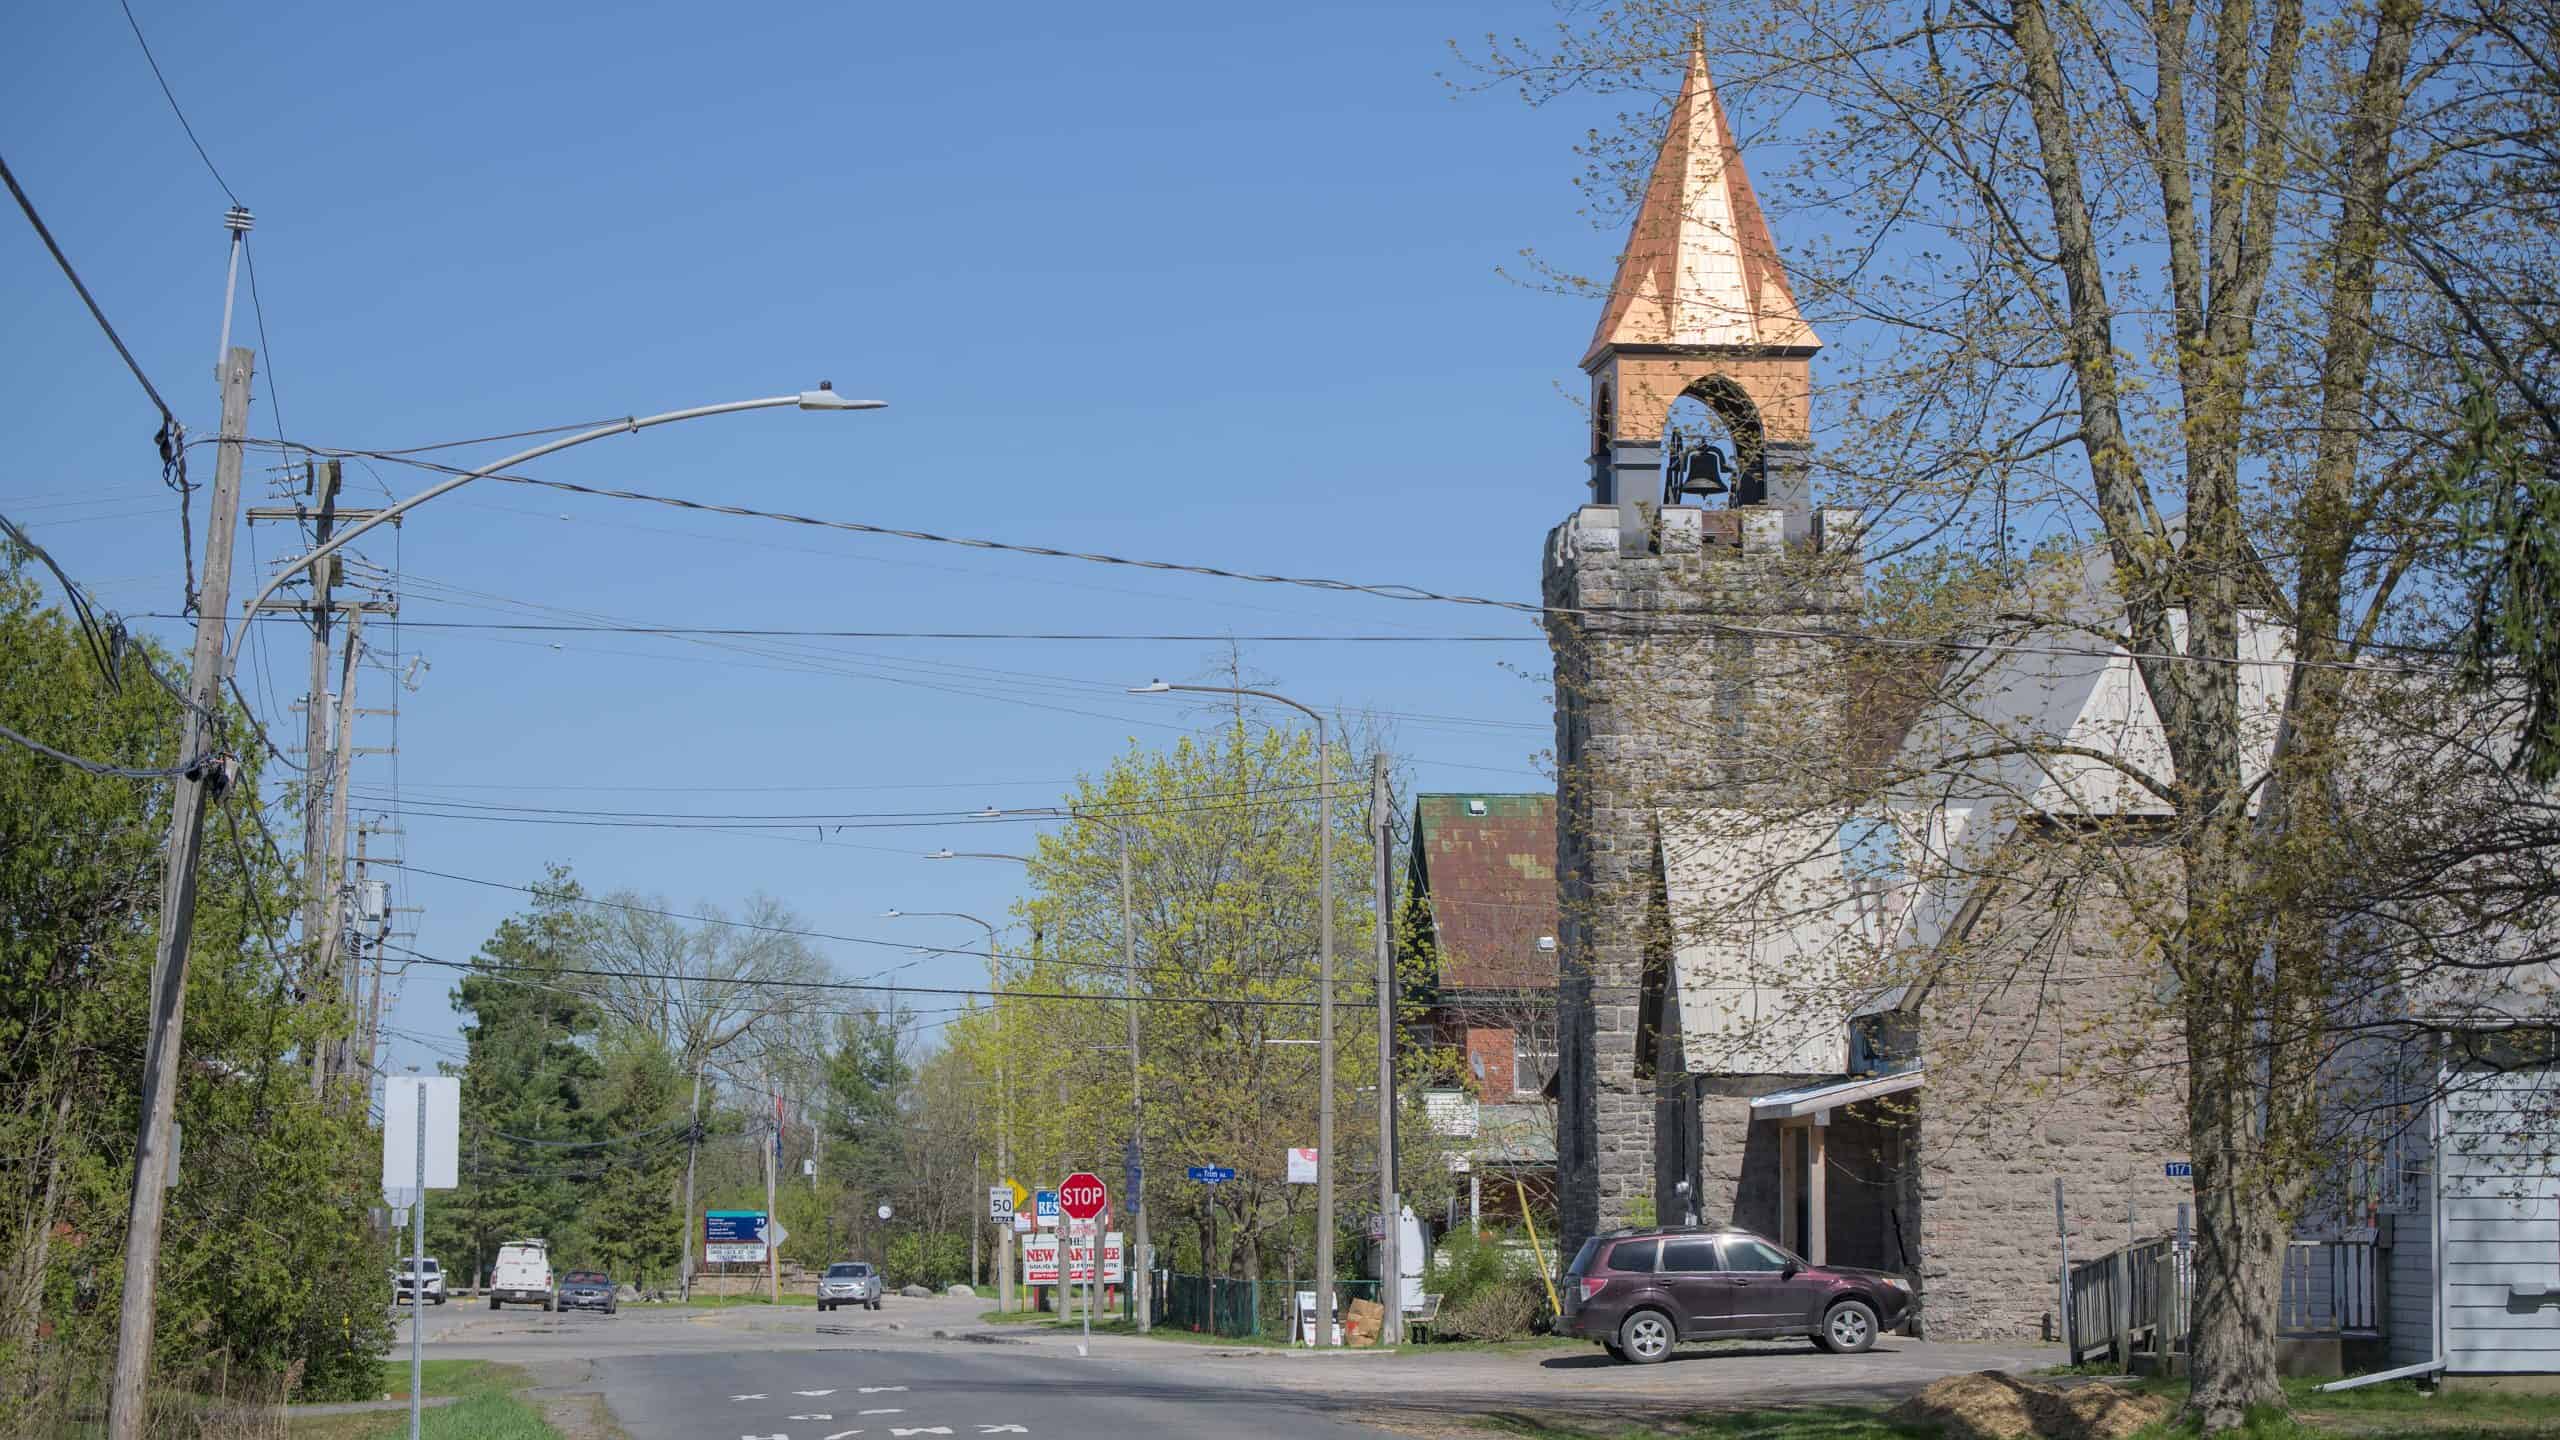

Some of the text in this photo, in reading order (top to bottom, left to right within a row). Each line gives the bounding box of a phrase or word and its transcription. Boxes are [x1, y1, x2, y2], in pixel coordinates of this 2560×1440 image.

[1062, 1187, 1103, 1207] STOP
[992, 1199, 1012, 1213] 50
[1026, 1248, 1056, 1262] NEW
[1086, 1247, 1120, 1260] TEE
